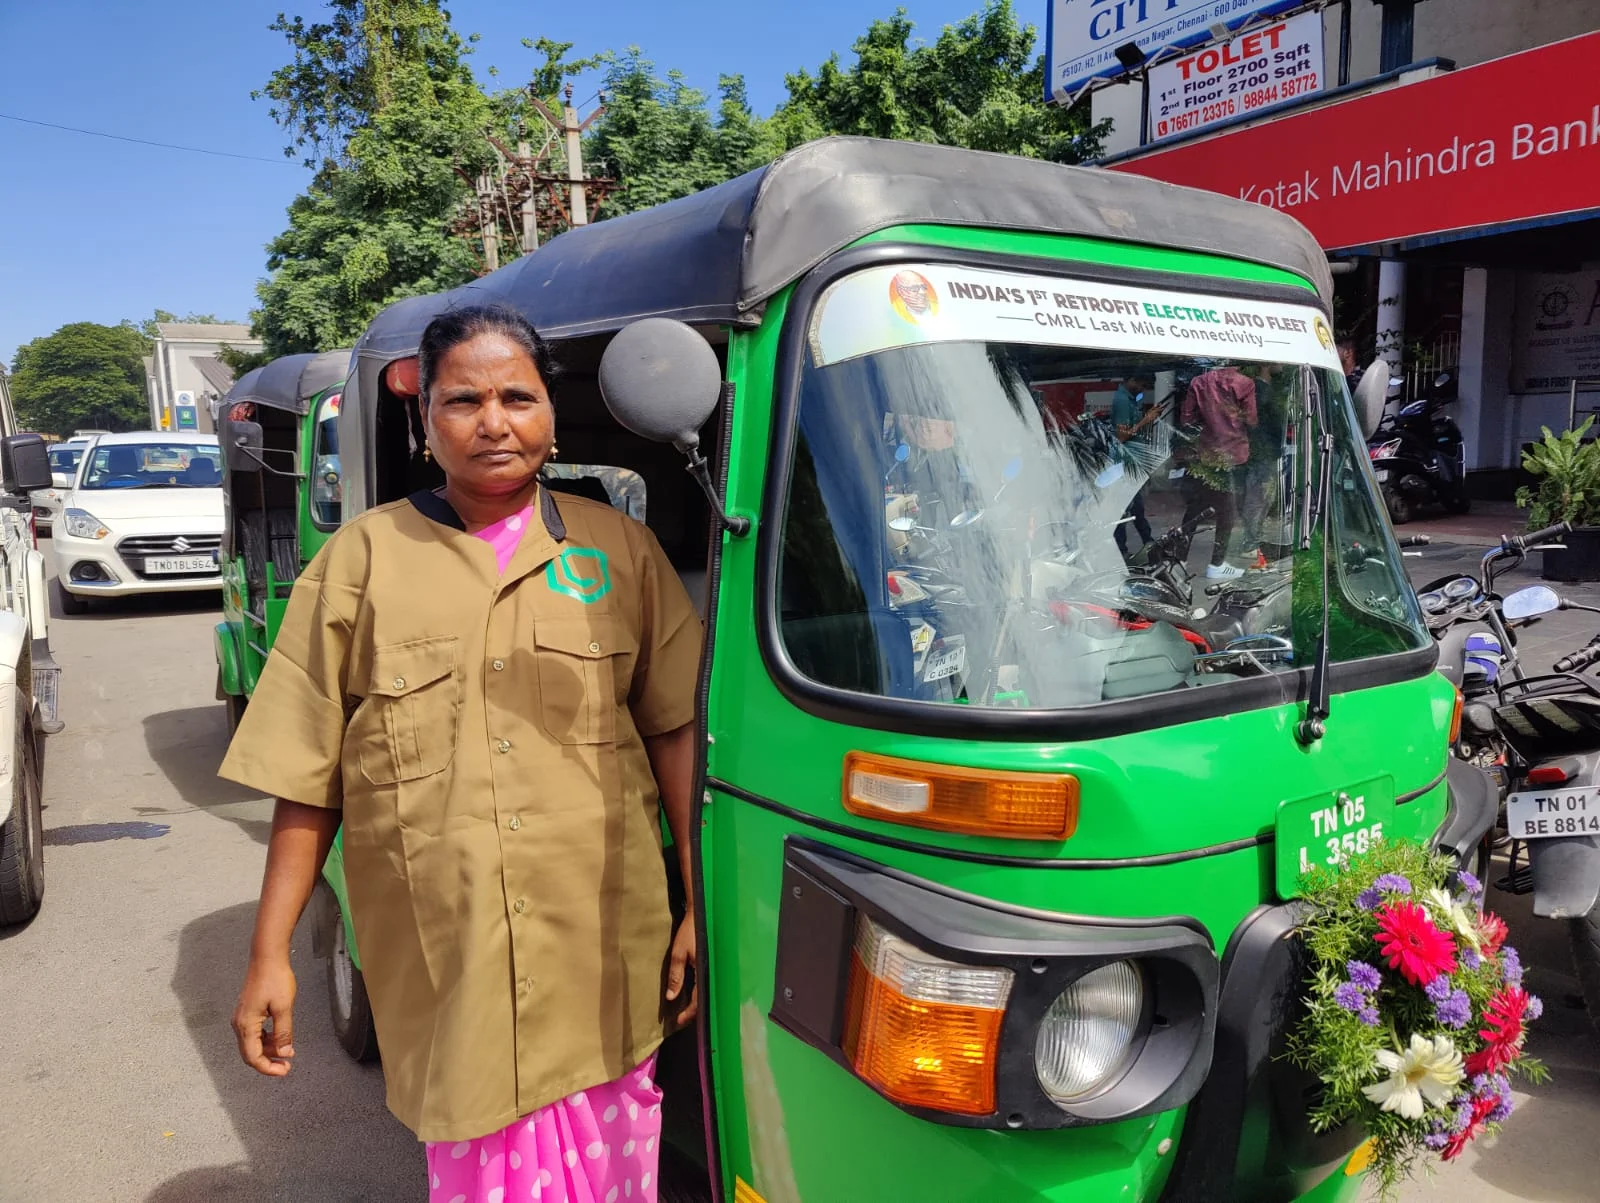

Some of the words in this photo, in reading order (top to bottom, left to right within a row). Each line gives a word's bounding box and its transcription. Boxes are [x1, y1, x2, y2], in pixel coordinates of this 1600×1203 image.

[1152, 27, 1175, 42] Nagar,
[1177, 11, 1208, 31] Chennai
[1214, 2, 1230, 17] 600
[1160, 88, 1177, 101] 1st
[1184, 75, 1223, 95] Floor
[1228, 58, 1268, 79] 2700
[1274, 43, 1311, 64] Sqft
[1176, 24, 1286, 80] TOLET
[1160, 101, 1180, 116] 2nd
[1184, 89, 1223, 108] Floor
[1228, 73, 1268, 94] 2700
[1274, 59, 1311, 79] Sqft
[1170, 109, 1199, 132] 76677
[1203, 98, 1235, 122] 23376
[1244, 87, 1278, 109] 98844
[1281, 72, 1317, 98] 58772
[1332, 136, 1495, 196] Mahindra
[1512, 104, 1600, 160] Bank
[947, 281, 1025, 305] INDIA'S
[1026, 289, 1047, 306] 1ST
[1052, 293, 1140, 316] RETROFIT
[1142, 302, 1221, 324] ELECTRIC
[1224, 311, 1265, 329] AUTO
[1265, 315, 1308, 334] FLEET
[1034, 312, 1087, 330] CMRL
[1089, 316, 1128, 333] Last
[1130, 320, 1166, 337] Mile
[1169, 324, 1264, 347] Connectivity
[1310, 805, 1338, 837] TN
[1343, 796, 1365, 826] 05
[1525, 820, 1548, 834] BE
[1555, 816, 1600, 833] 8814
[1535, 797, 1560, 812] TN
[1566, 795, 1586, 810] 01
[1326, 822, 1383, 865] 3585
